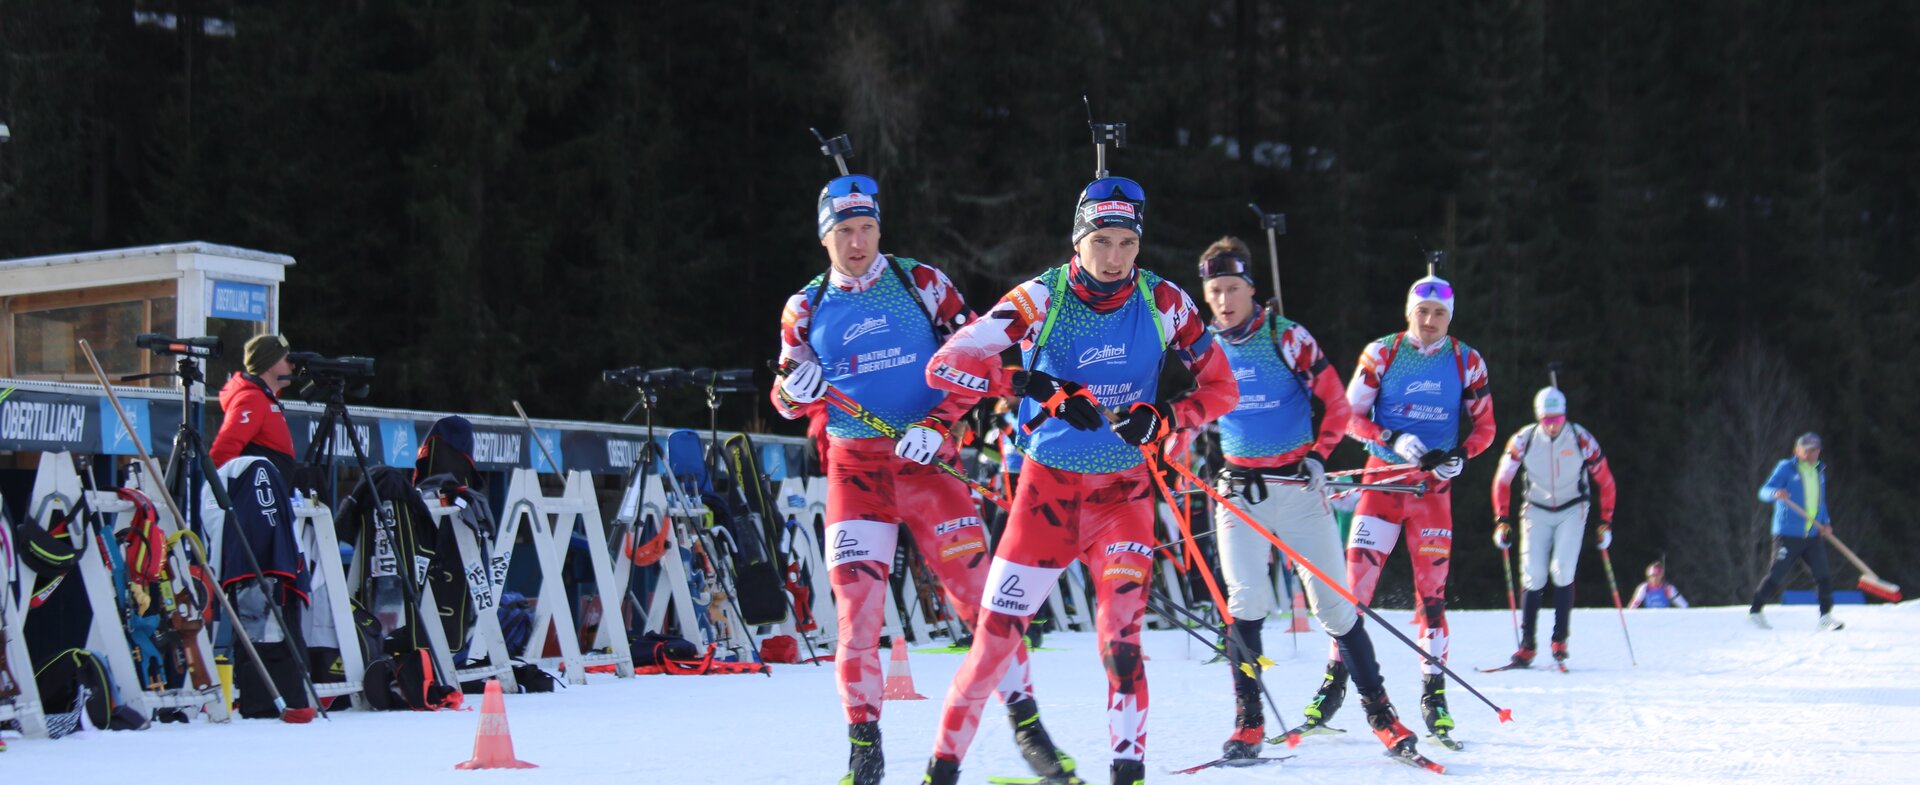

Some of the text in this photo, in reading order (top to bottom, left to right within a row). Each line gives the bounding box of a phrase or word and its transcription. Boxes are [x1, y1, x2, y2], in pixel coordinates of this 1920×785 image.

[1098, 201, 1132, 212] saalbach
[858, 347, 901, 363] BIATHLON
[858, 353, 917, 373] OBERTILLIACH
[1077, 343, 1127, 369] Osttirol
[1088, 382, 1132, 396] BIATHLON
[1096, 389, 1143, 407] ERTILLIACH
[1, 400, 86, 443] OBERTILLIACH
[254, 467, 277, 527] AUT
[475, 591, 493, 611] 25
[991, 596, 1029, 611] Löffler
